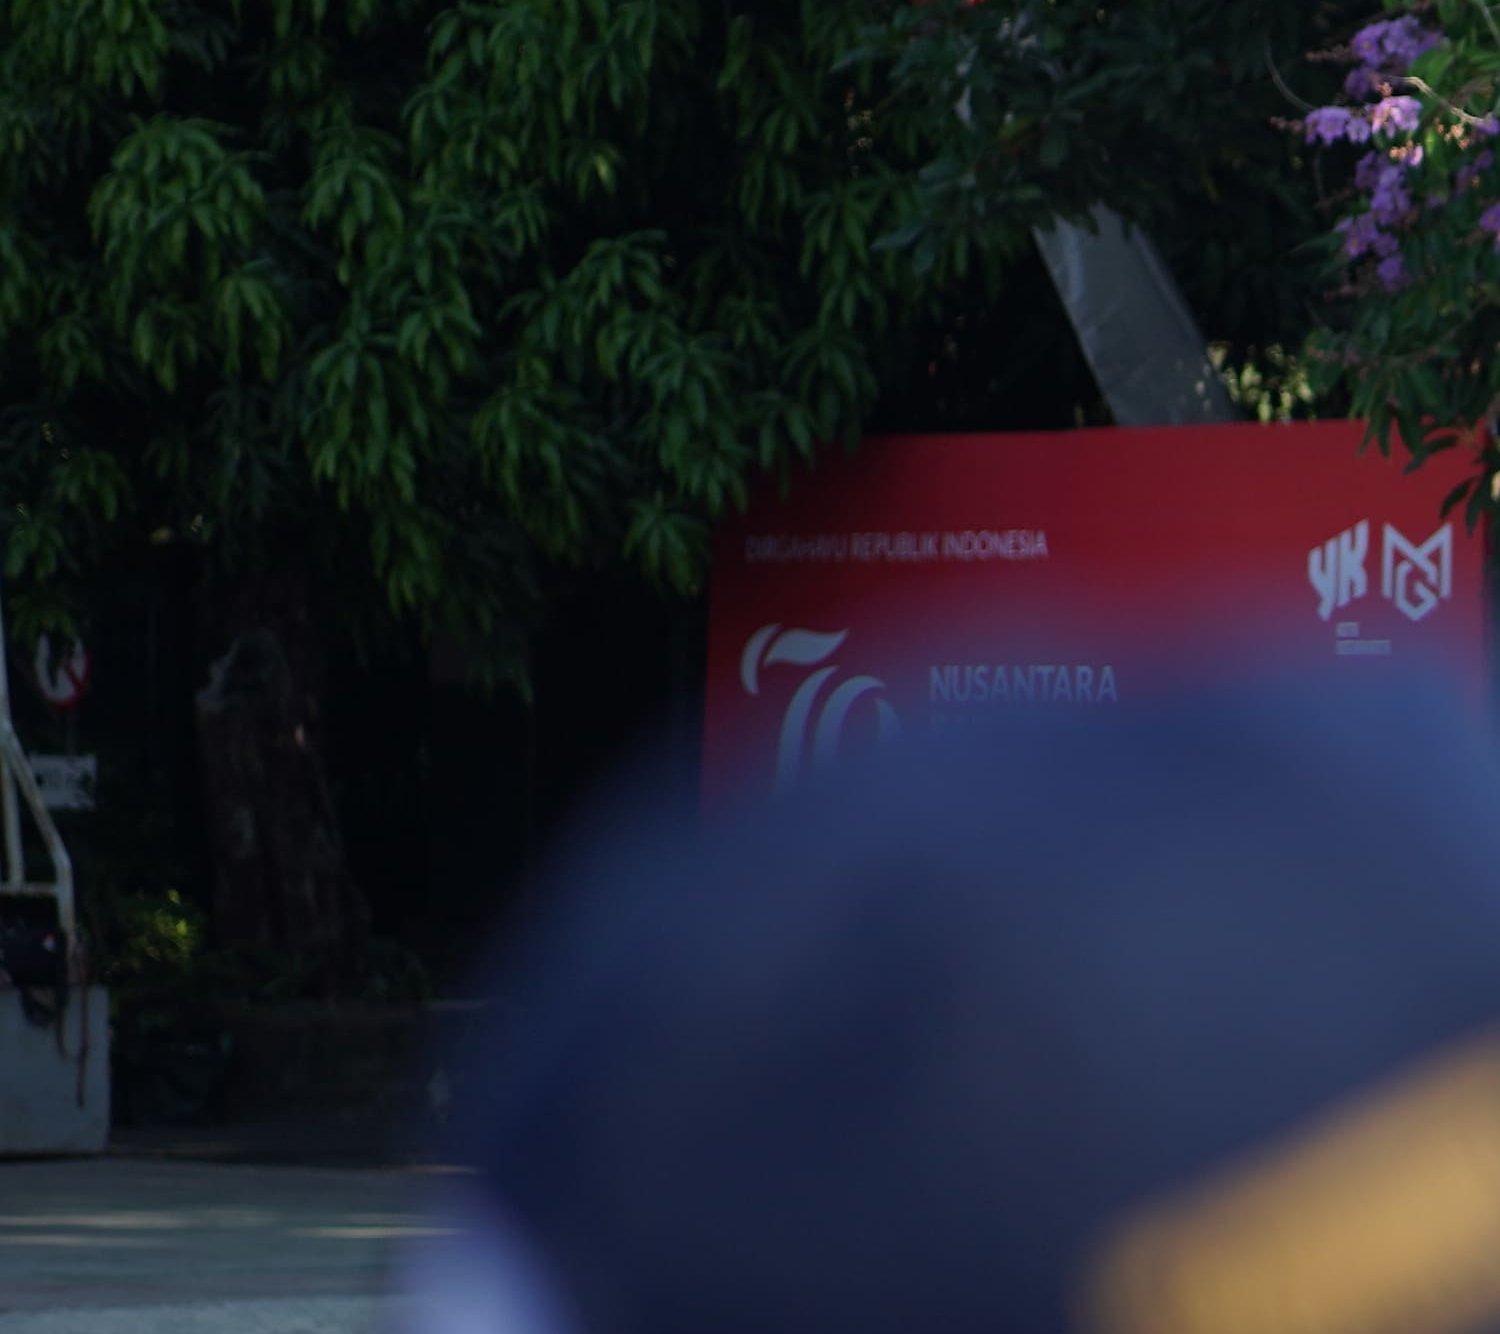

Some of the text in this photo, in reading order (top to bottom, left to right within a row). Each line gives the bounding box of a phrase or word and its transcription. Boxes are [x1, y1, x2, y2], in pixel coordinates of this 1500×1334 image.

[850, 531, 939, 561] REPUBLIK
[941, 529, 1049, 560] INDONESIA
[928, 664, 1119, 703] NUSANTARA
